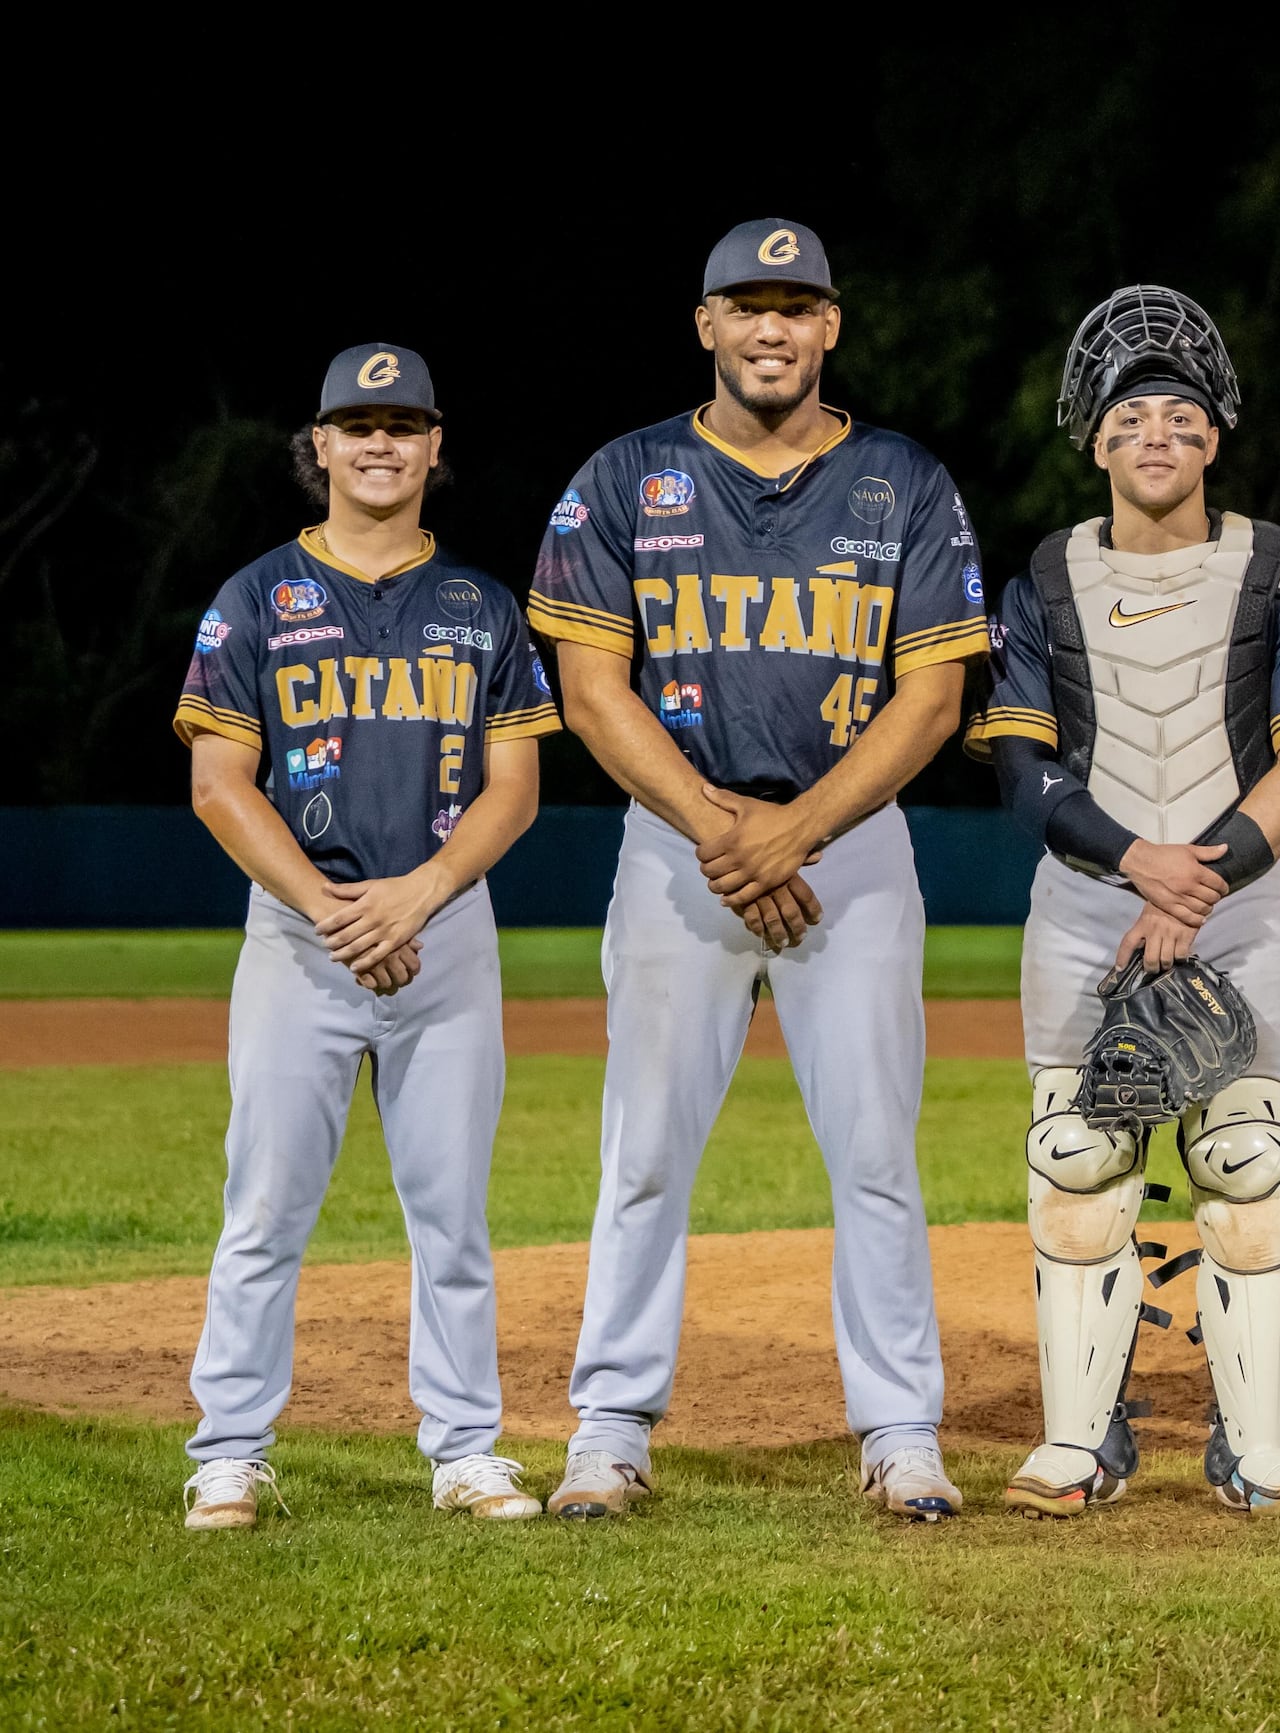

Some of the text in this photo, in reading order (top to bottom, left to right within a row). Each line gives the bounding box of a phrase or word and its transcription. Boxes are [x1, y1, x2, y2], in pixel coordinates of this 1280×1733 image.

[634, 537, 702, 548] ECONO
[270, 628, 341, 648] ECONO
[633, 560, 894, 667] CATAÑO
[820, 673, 878, 747] 45
[439, 734, 466, 794] 2
